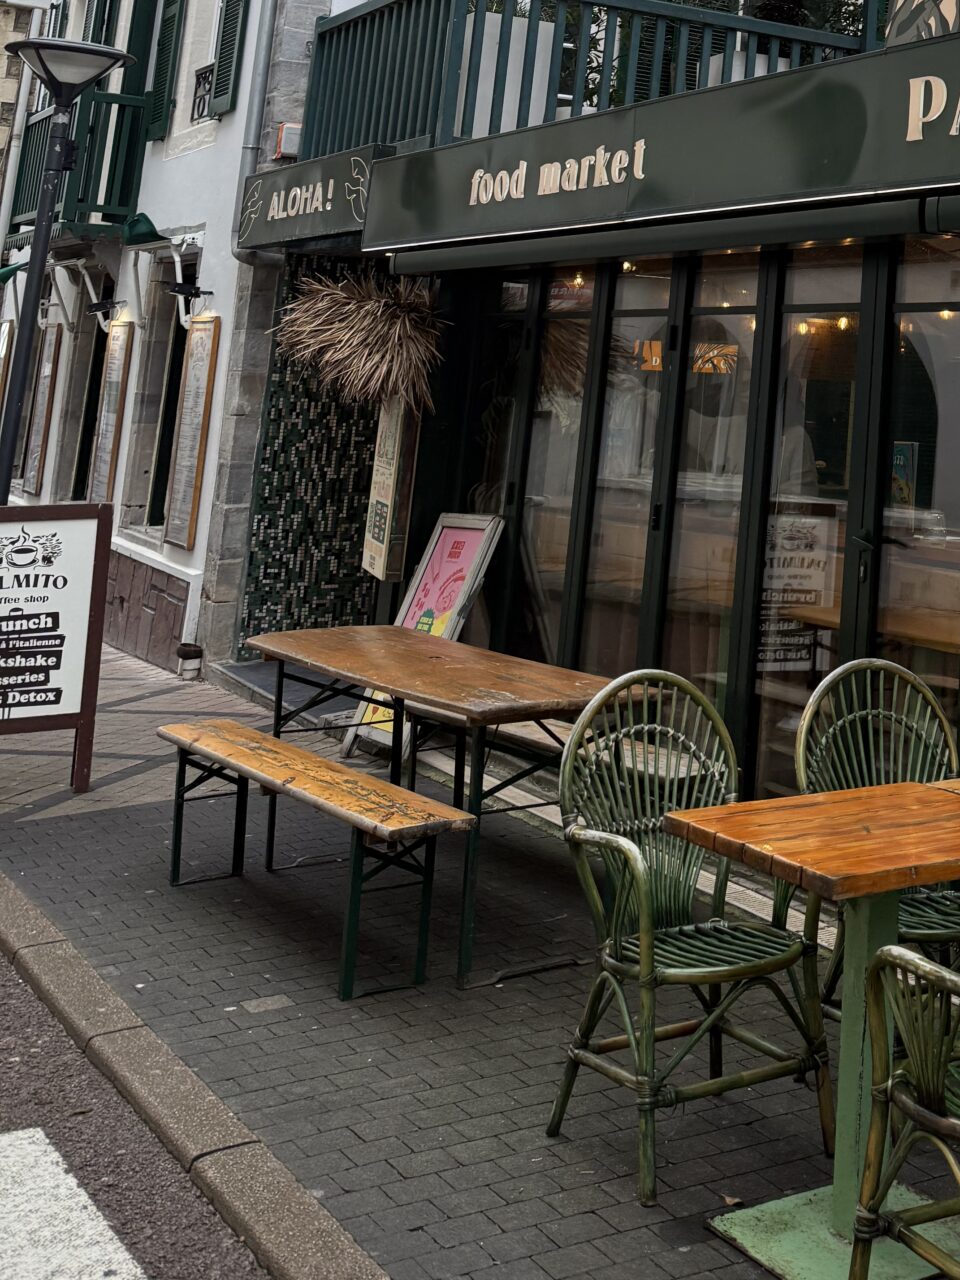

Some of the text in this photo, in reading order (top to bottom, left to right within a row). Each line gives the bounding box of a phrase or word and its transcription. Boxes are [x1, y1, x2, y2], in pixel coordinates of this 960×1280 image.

[470, 139, 646, 206] food market
[24, 595, 49, 603] shop
[7, 691, 56, 704] Detox
